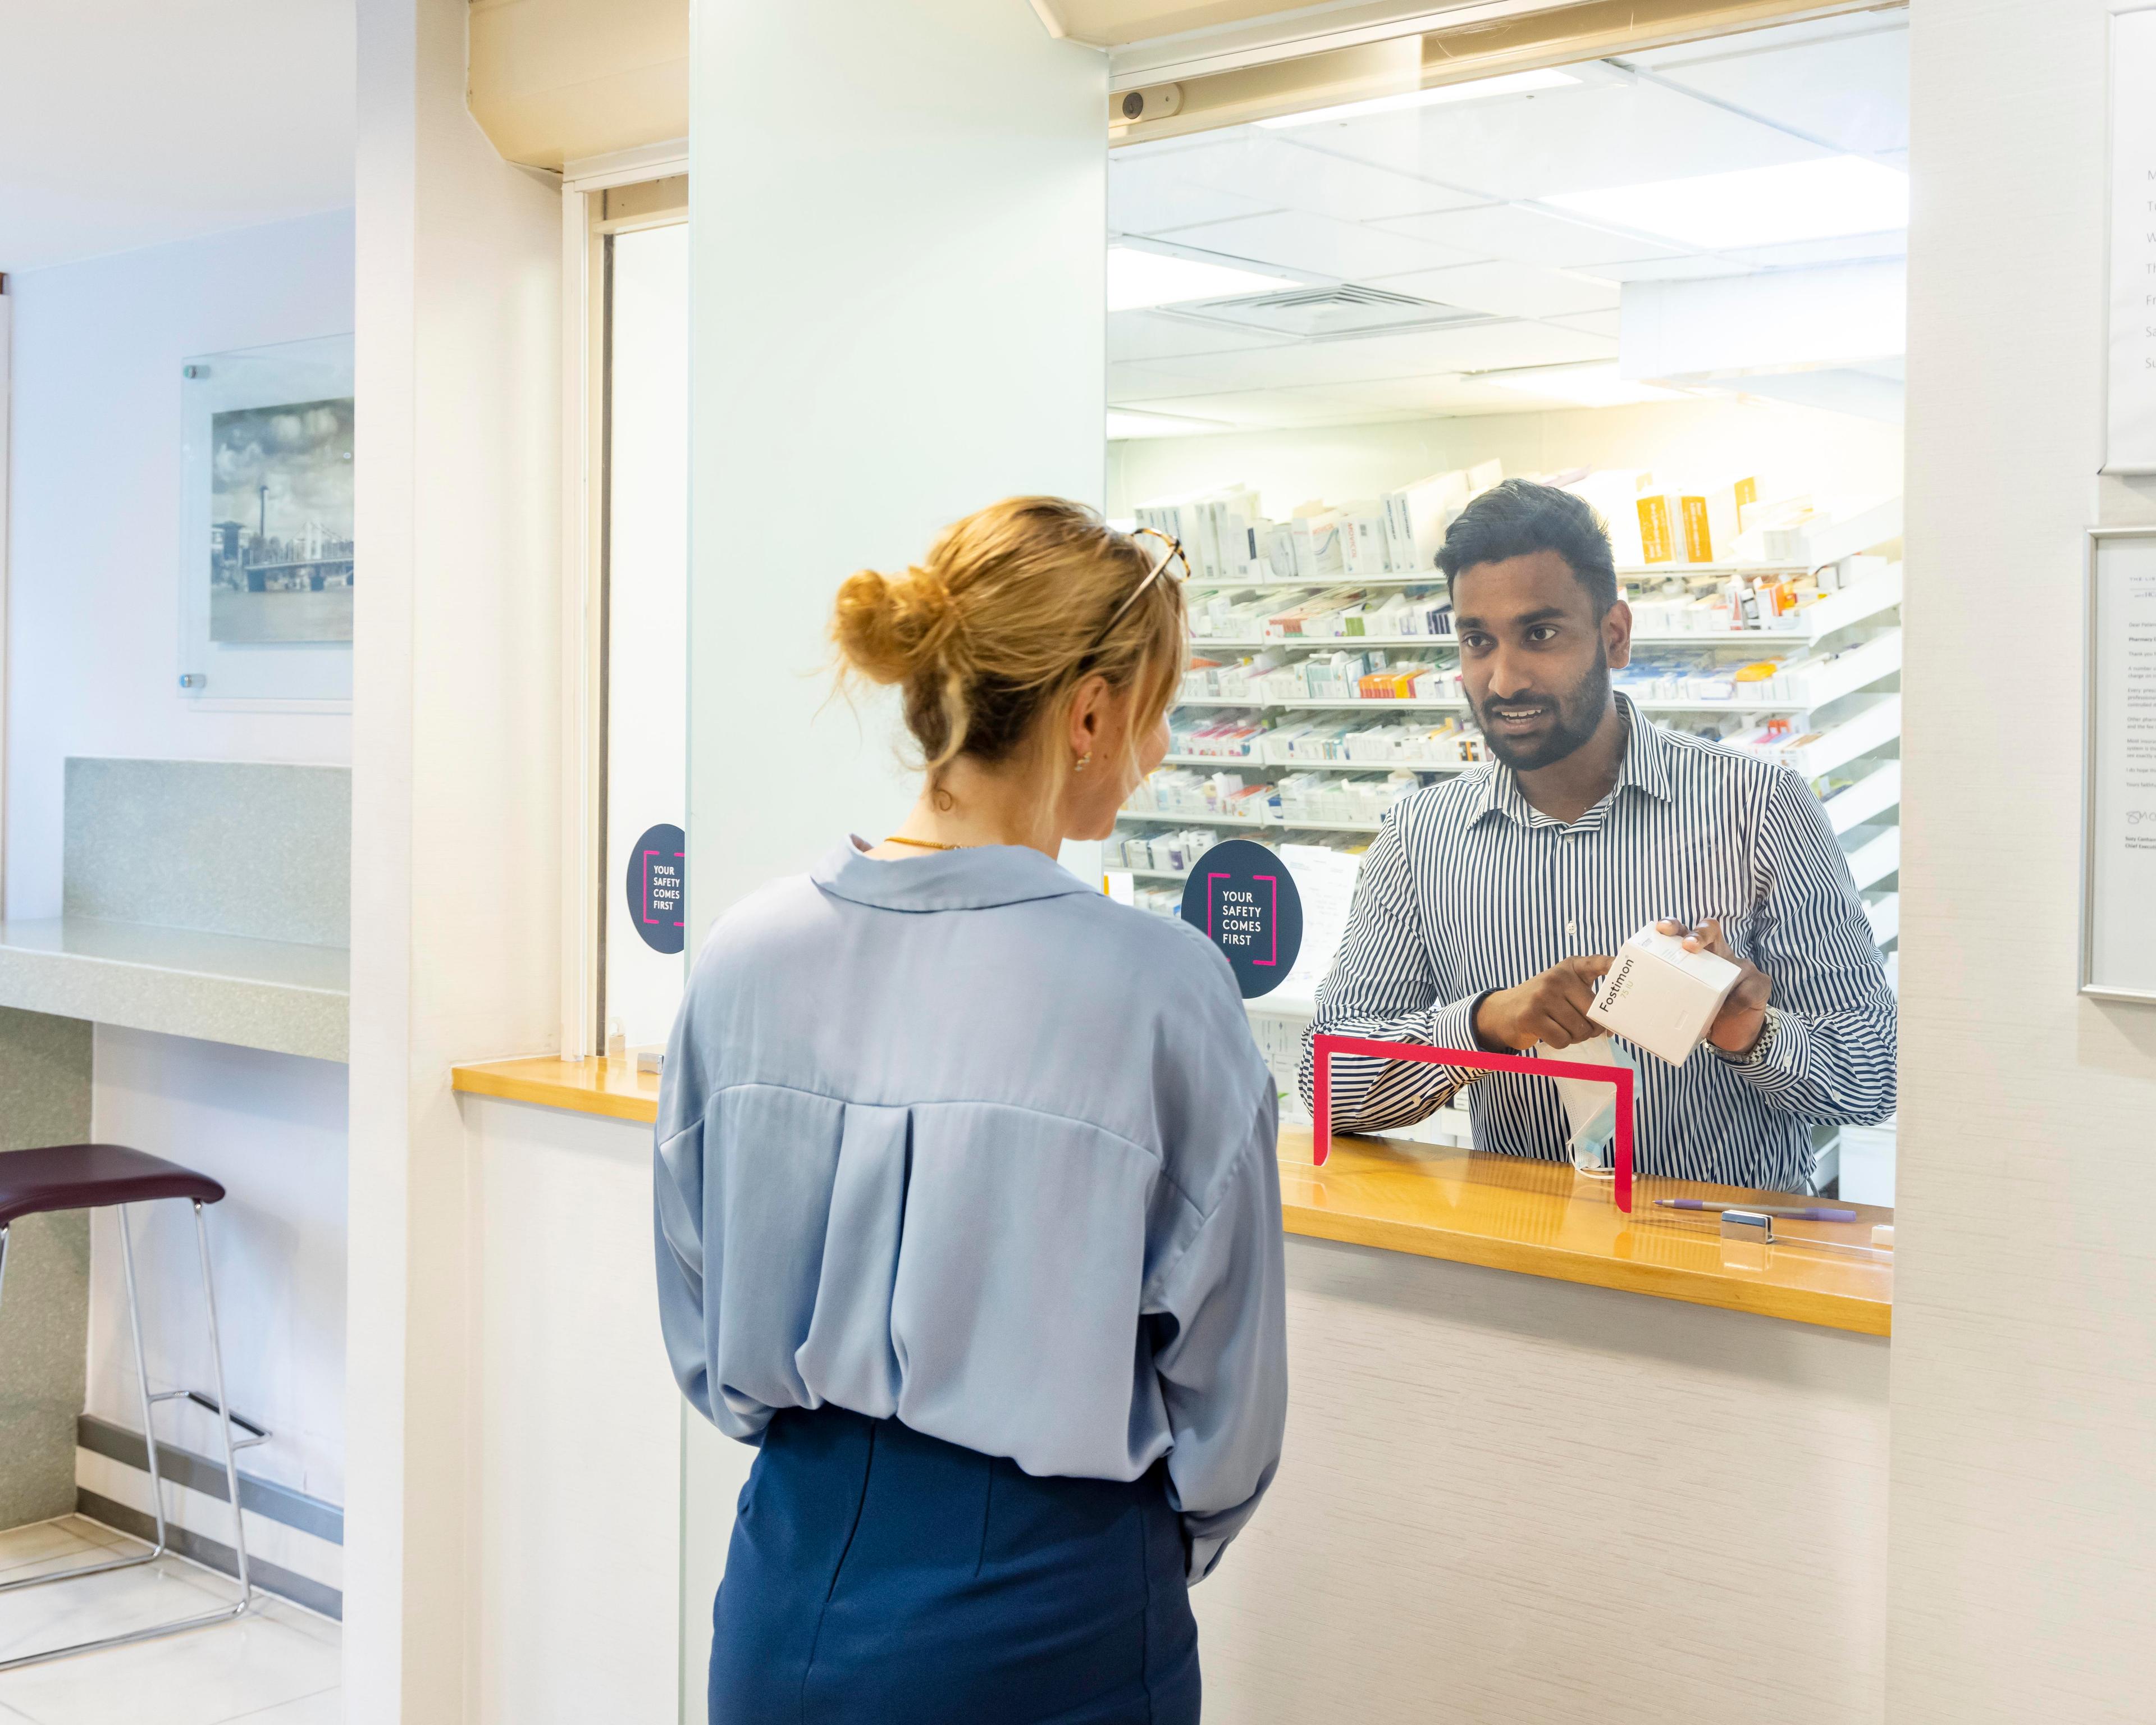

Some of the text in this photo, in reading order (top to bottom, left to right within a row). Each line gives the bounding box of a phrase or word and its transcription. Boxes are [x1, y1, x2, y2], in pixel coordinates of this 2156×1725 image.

[654, 865, 675, 875] YOUR
[653, 877, 680, 887] SAFETY
[653, 888, 680, 900] COMES
[1222, 891, 1253, 903] YOUR
[653, 900, 674, 910] FIRST
[1222, 905, 1262, 918] SAFETY
[1222, 919, 1261, 932] COMES
[1223, 933, 1251, 946] FIRST
[1620, 989, 1629, 998] 75
